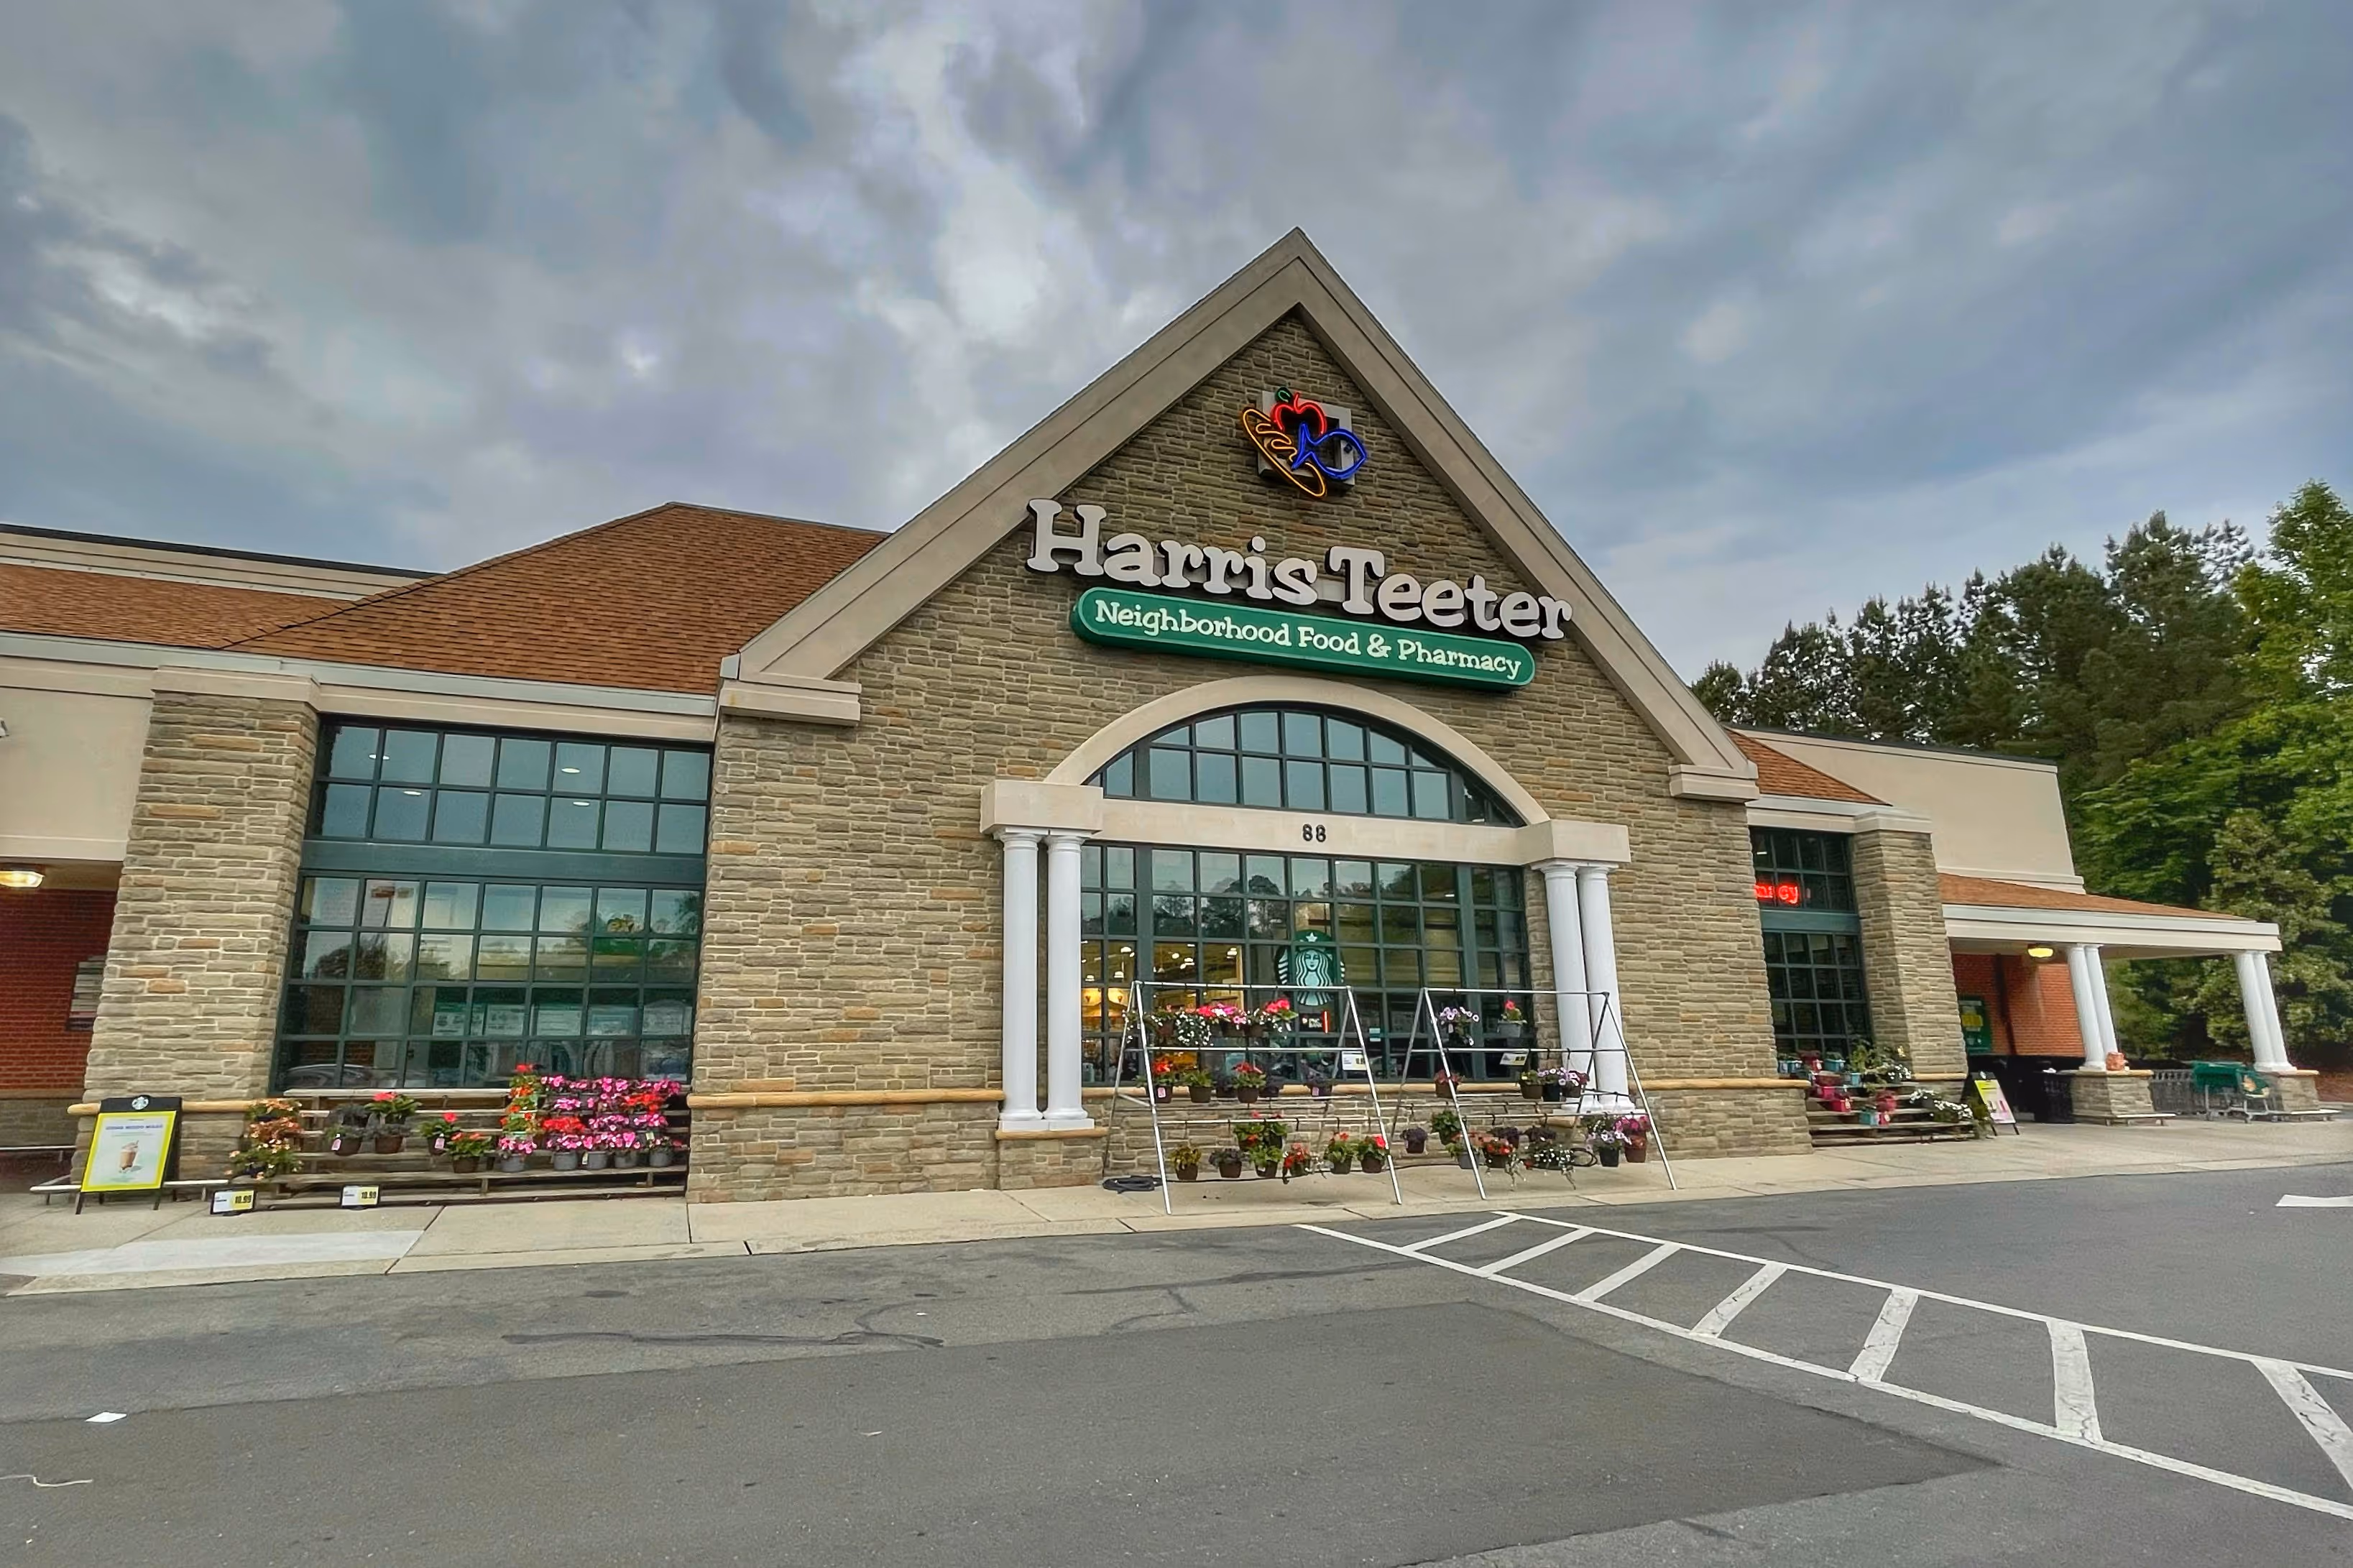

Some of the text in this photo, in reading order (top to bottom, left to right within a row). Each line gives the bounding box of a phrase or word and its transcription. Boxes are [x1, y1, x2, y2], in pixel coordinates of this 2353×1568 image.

[1026, 499, 1573, 639] Harris Teeter
[1095, 599, 1521, 680] Neighborhood Food & Pharmacy
[1302, 824, 1326, 842] 88
